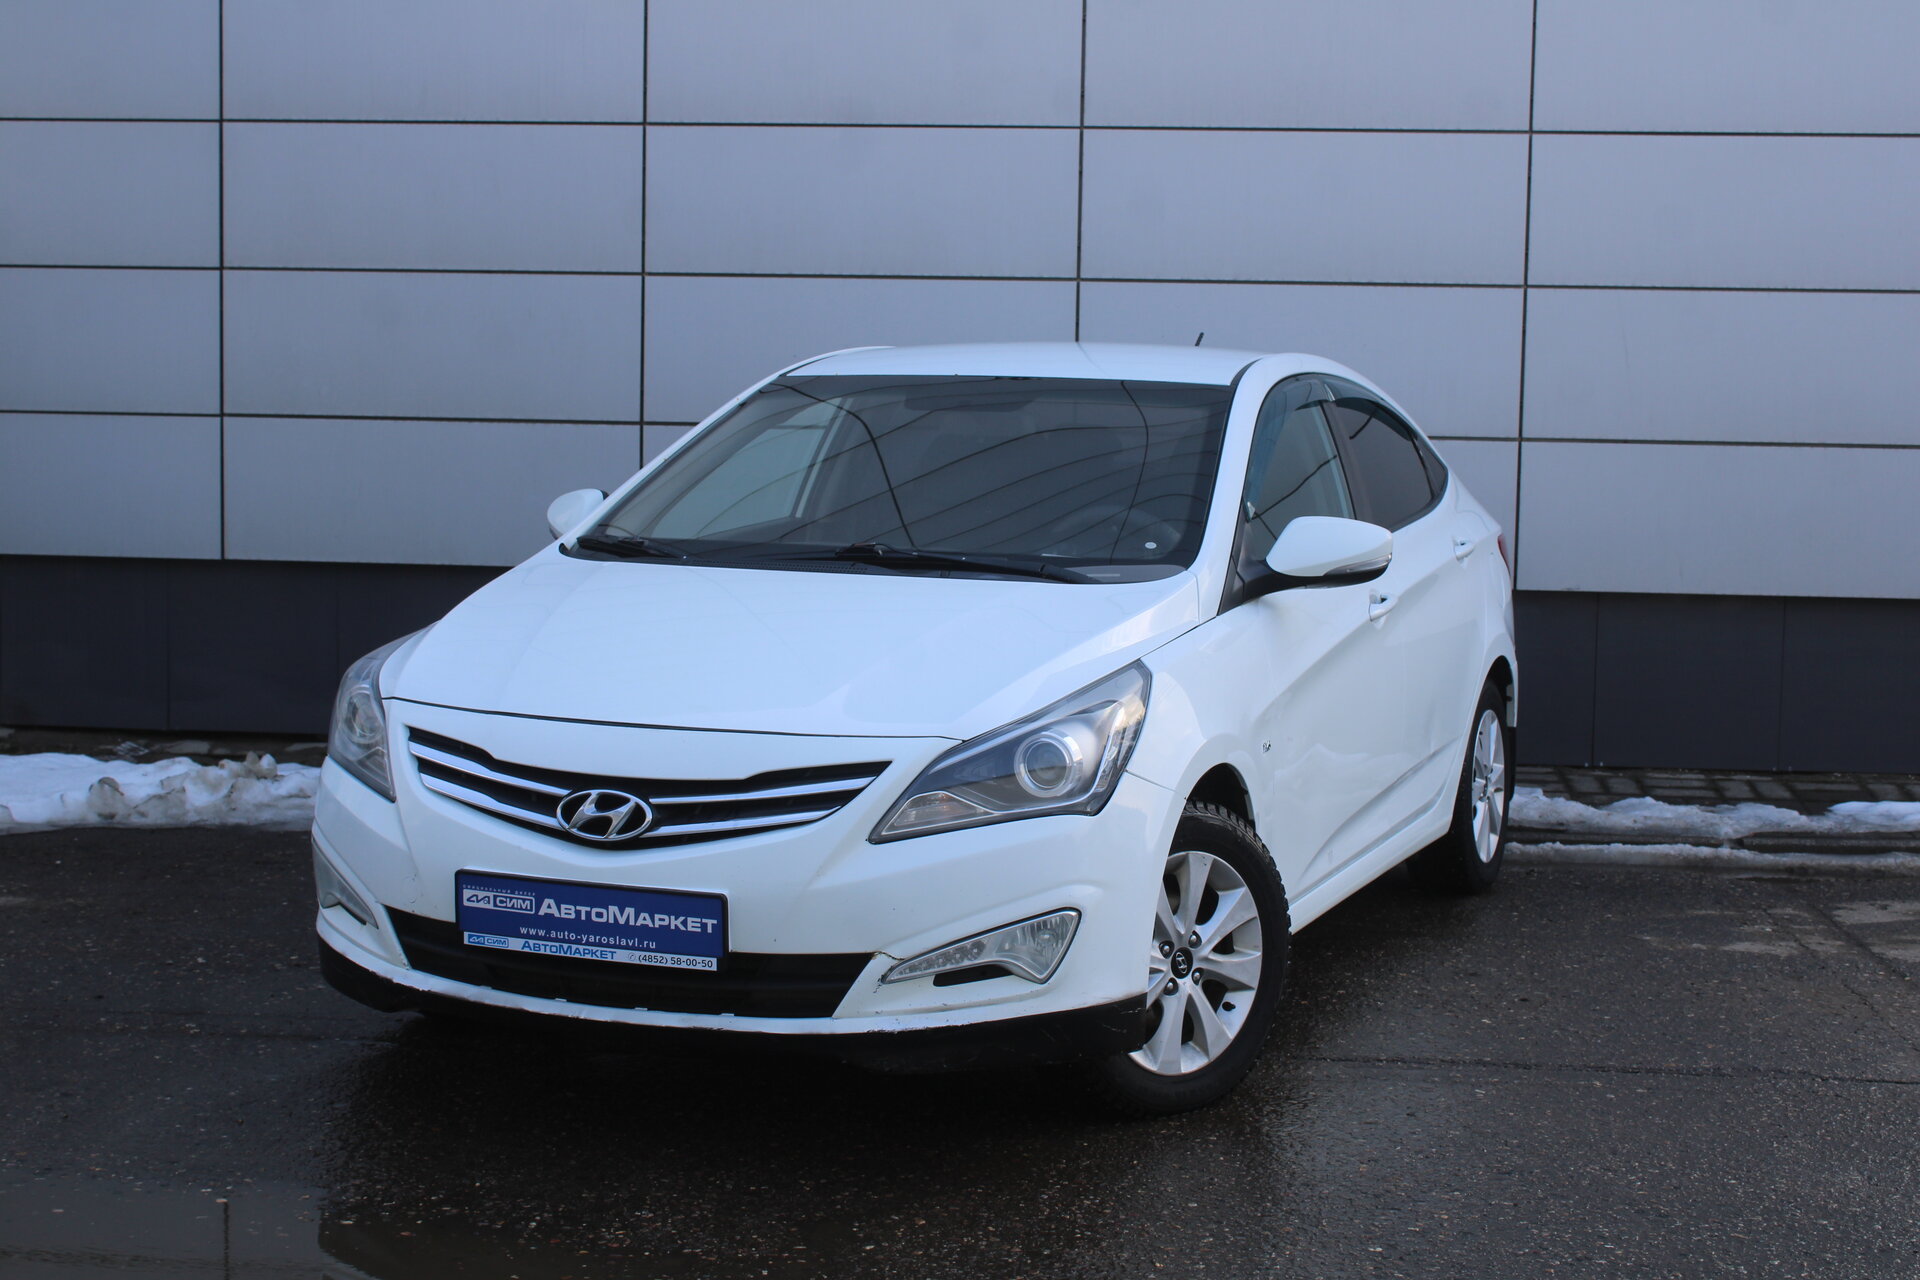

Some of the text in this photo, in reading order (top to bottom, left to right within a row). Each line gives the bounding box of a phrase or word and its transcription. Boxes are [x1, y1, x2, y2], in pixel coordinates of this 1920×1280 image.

[496, 897, 531, 910] СИМ
[519, 926, 656, 949] www.auto-yaroslavl.ru
[486, 937, 507, 946] СИМ
[638, 953, 668, 965] (4852)
[670, 956, 713, 968] 58-00-50
